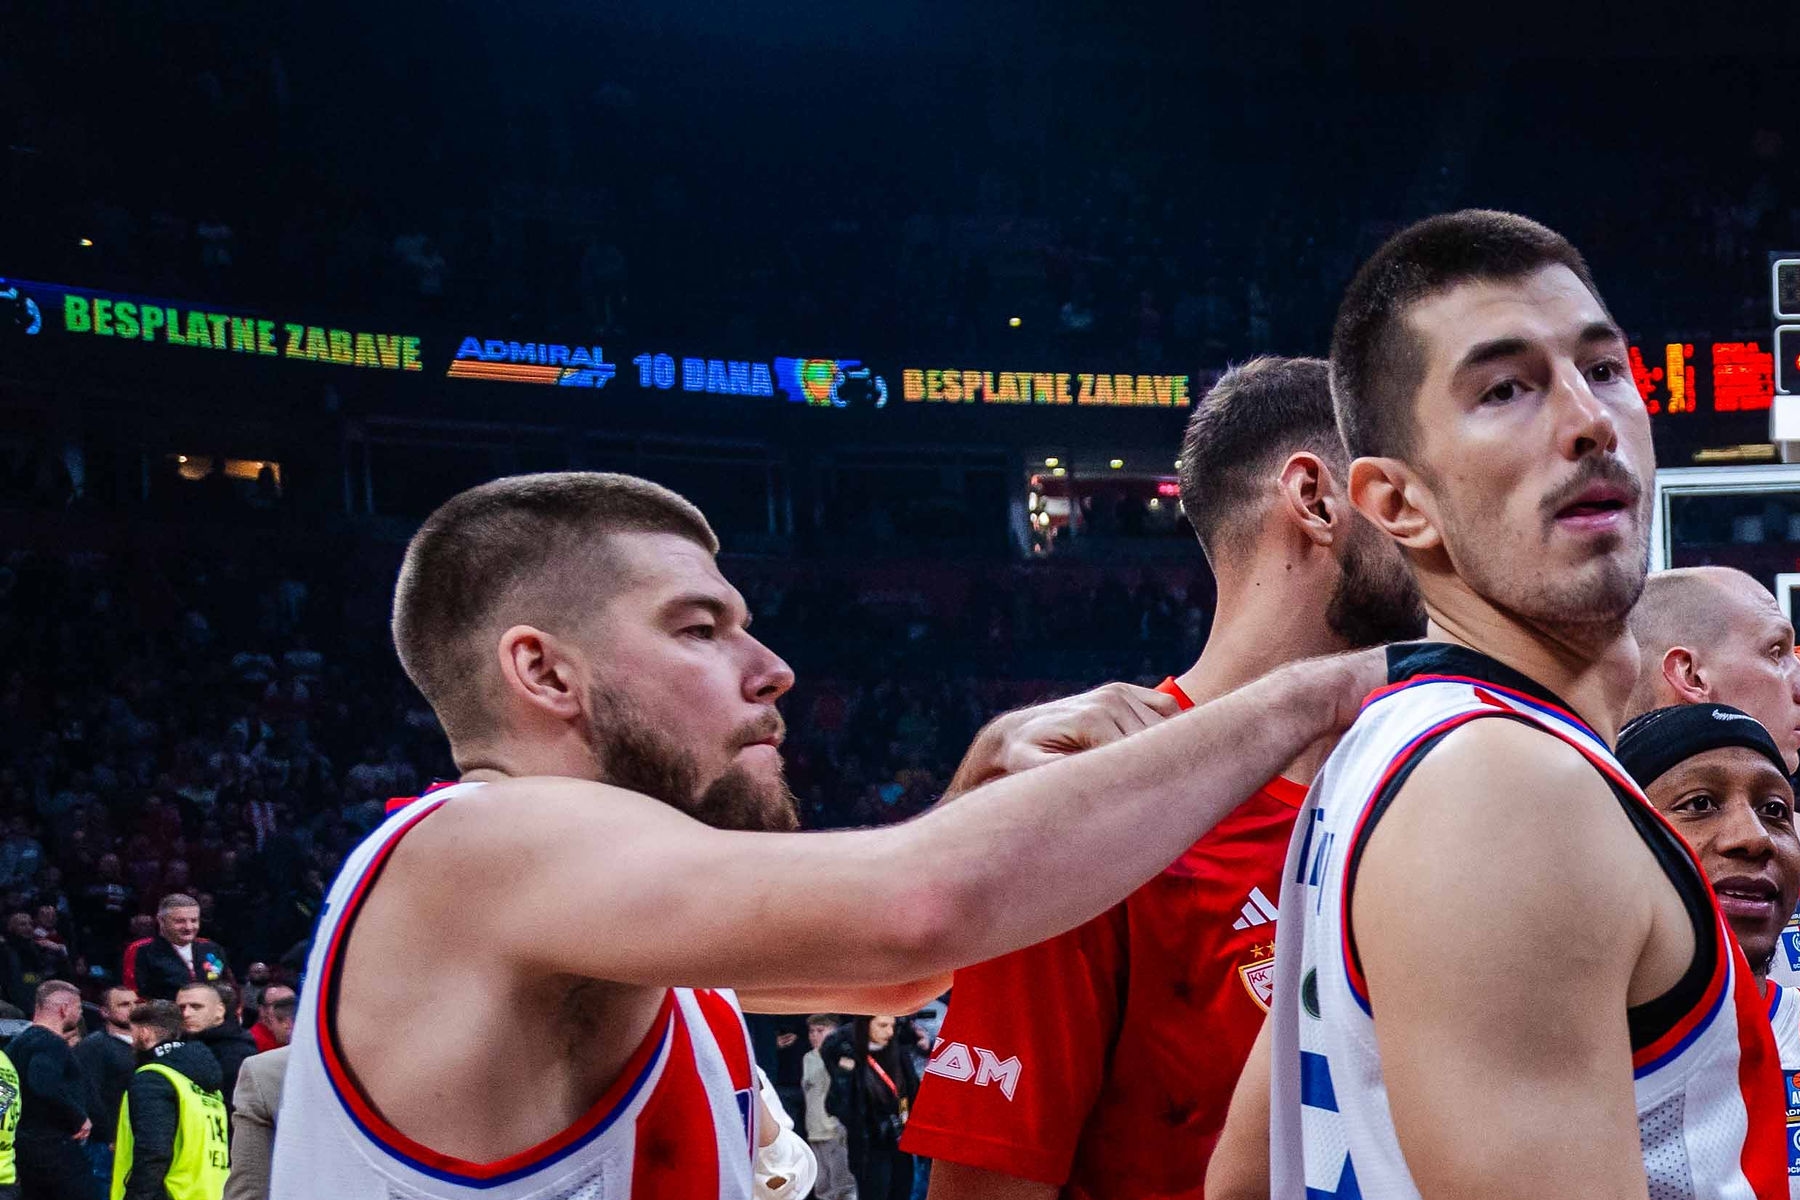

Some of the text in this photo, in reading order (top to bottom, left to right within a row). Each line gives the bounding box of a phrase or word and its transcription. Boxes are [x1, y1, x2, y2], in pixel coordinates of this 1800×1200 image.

[64, 294, 423, 371] BESPLATNE ZABAVE
[456, 336, 616, 371] ADMIRAL
[633, 352, 675, 389] 10
[902, 369, 1191, 407] BESPLATNE ZABAVE
